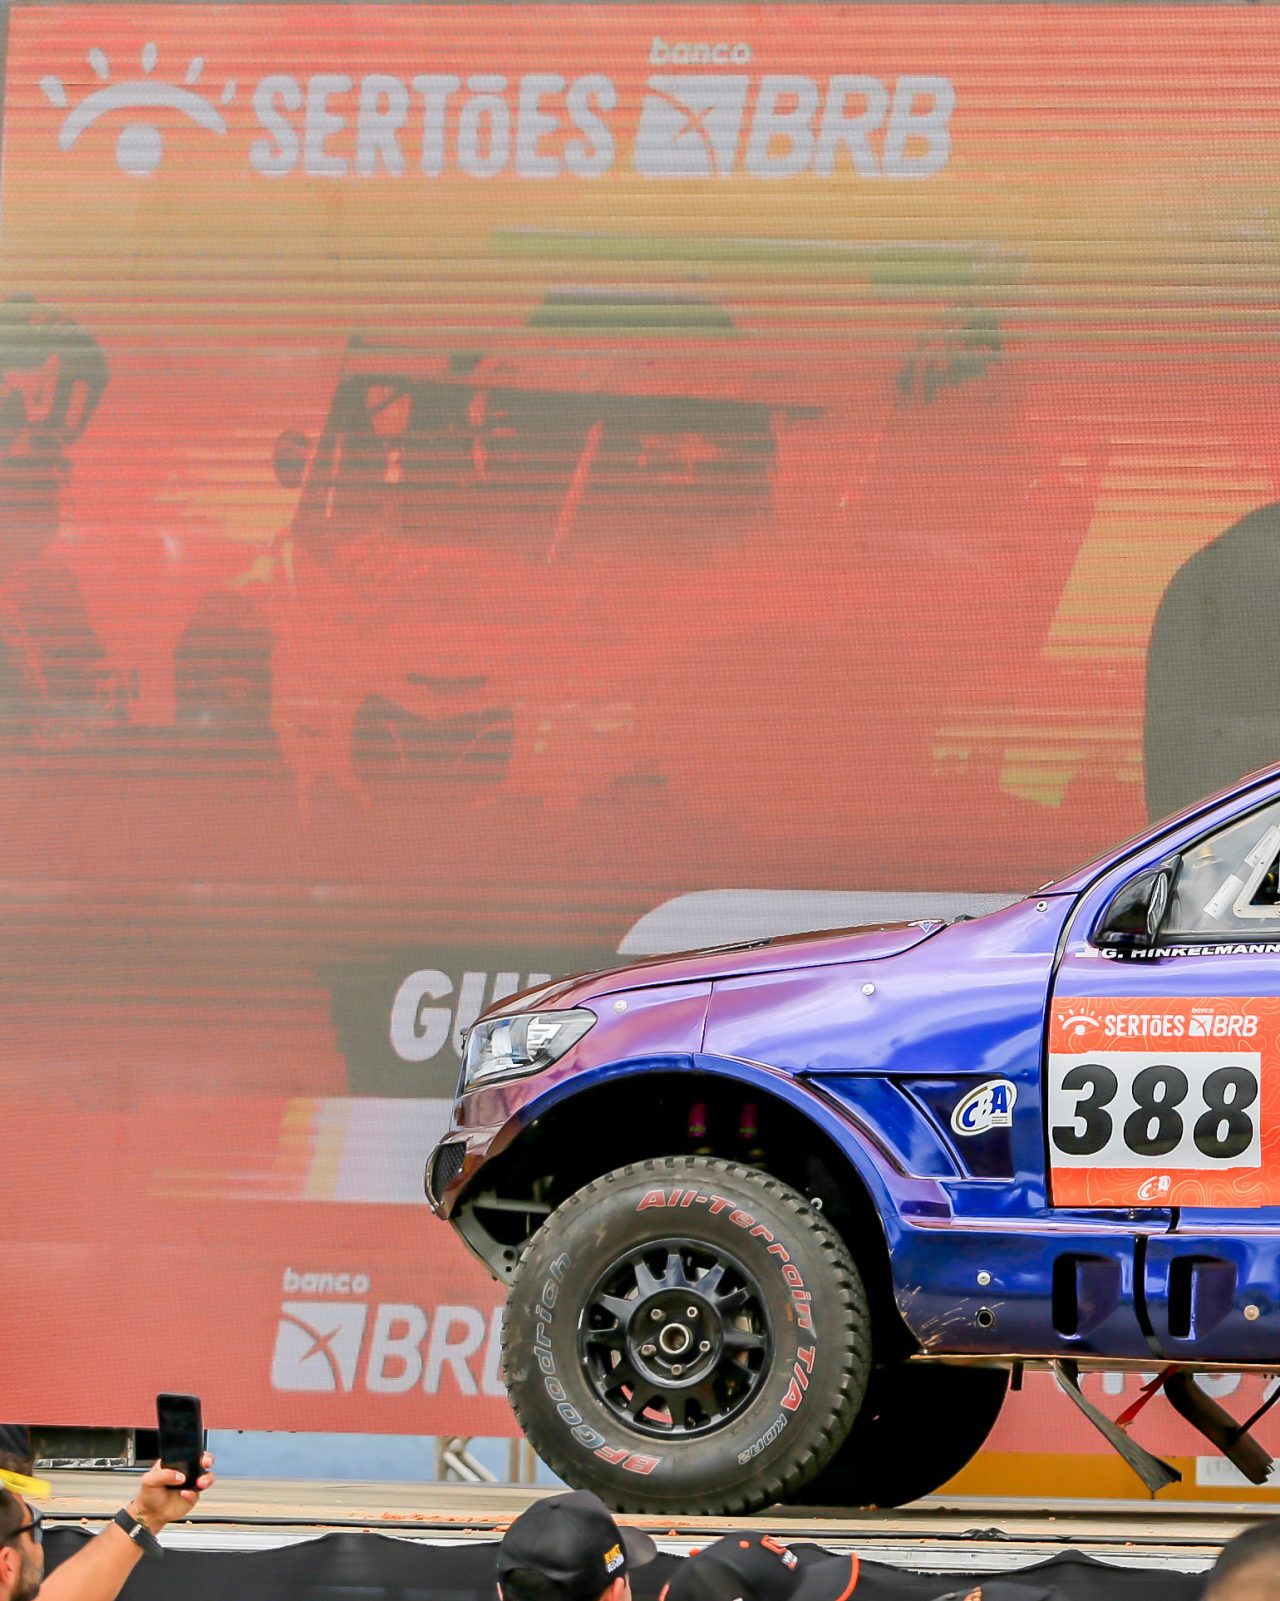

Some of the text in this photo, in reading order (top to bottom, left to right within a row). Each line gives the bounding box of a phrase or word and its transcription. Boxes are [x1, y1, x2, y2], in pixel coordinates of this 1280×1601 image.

[650, 36, 752, 65] banco
[744, 74, 956, 178] BRB
[1212, 1015, 1258, 1037] BRB
[1052, 1063, 1259, 1159] 388
[283, 1267, 371, 1295] banco
[637, 1188, 814, 1328] All-Terrain
[780, 1345, 816, 1411] T/A
[533, 1252, 663, 1475] BFGoodrich
